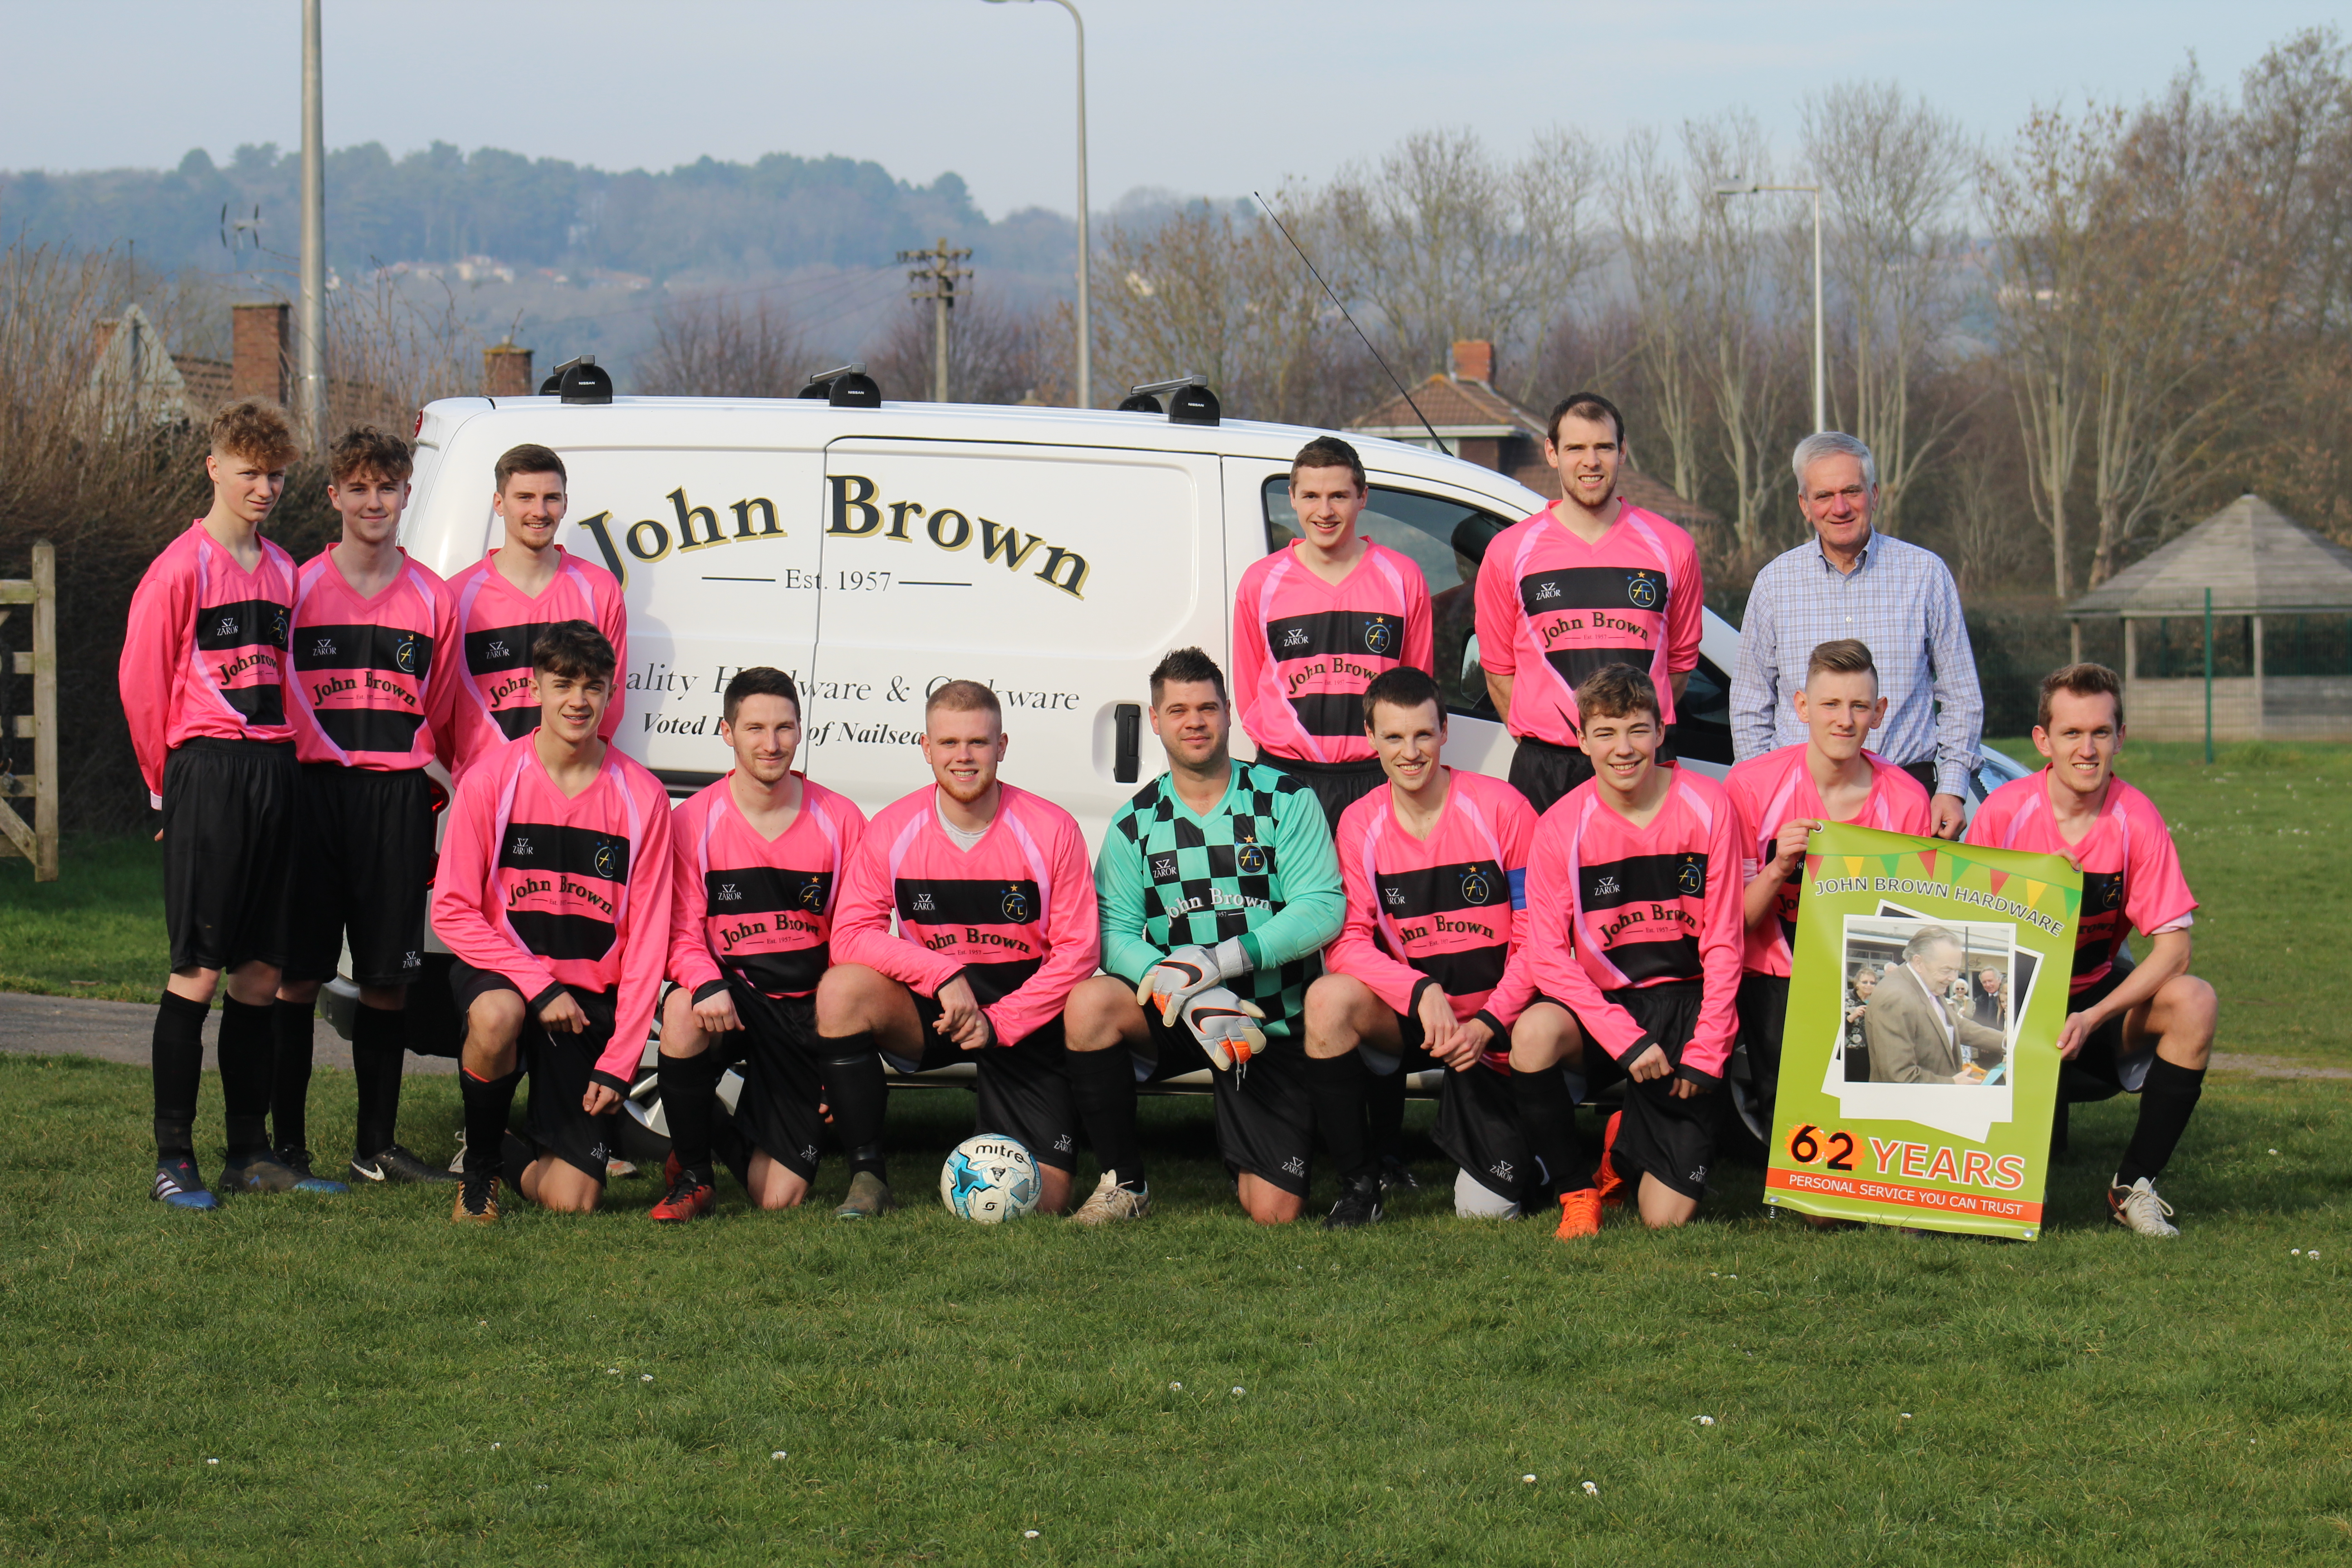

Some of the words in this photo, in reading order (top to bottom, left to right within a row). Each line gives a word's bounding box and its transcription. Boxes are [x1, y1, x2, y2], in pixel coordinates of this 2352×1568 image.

[578, 485, 788, 593] John
[826, 474, 1091, 601] Brown
[785, 569, 828, 591] Est.
[839, 571, 892, 593] 1957
[1536, 589, 1561, 601] ZAROR
[217, 625, 239, 636] ZAROR
[1284, 636, 1309, 647] ZAROR
[1542, 618, 1584, 648] John
[1591, 612, 1648, 642] Brown
[313, 647, 337, 656] ZAROR
[485, 648, 510, 659] ZAROR
[218, 654, 258, 686] John
[626, 663, 700, 701] ality
[886, 675, 910, 702] &
[1288, 663, 1326, 695] John
[1332, 657, 1378, 681] Brow
[313, 676, 357, 706] John
[364, 671, 417, 708] Brown
[489, 677, 529, 708] John
[644, 713, 707, 735] Voted
[808, 721, 835, 747] of
[838, 722, 921, 745] Nailsea
[513, 846, 533, 855] ZAROR
[1152, 866, 1177, 878] ZAROR
[508, 877, 551, 907] John
[558, 875, 613, 916] Brown
[718, 892, 742, 901] ZAROR
[1594, 885, 1620, 896] ZAROR
[1165, 896, 1205, 928] John
[1209, 887, 1271, 911] Brown
[1815, 877, 1868, 896] JOHN
[1874, 877, 1949, 899] BROWN
[1954, 886, 2065, 938] HARDWARE
[720, 922, 768, 951] John
[921, 933, 959, 951] ohn
[965, 927, 1031, 954] Brown
[1433, 915, 1495, 940] Brown
[1598, 911, 1647, 947] John
[976, 1144, 1025, 1163] mitre
[1791, 1125, 1853, 1171] 62
[1867, 1136, 2025, 1191] YEARS
[1282, 1161, 1304, 1178] ZAROR
[1490, 1165, 1513, 1182] ZAROR
[1789, 1174, 1856, 1194] PERSONAL
[1859, 1184, 1915, 1202] SERVICE
[1919, 1191, 1945, 1205] YOU
[1949, 1196, 1976, 1210] CAN
[1980, 1199, 2024, 1215] TRUST
